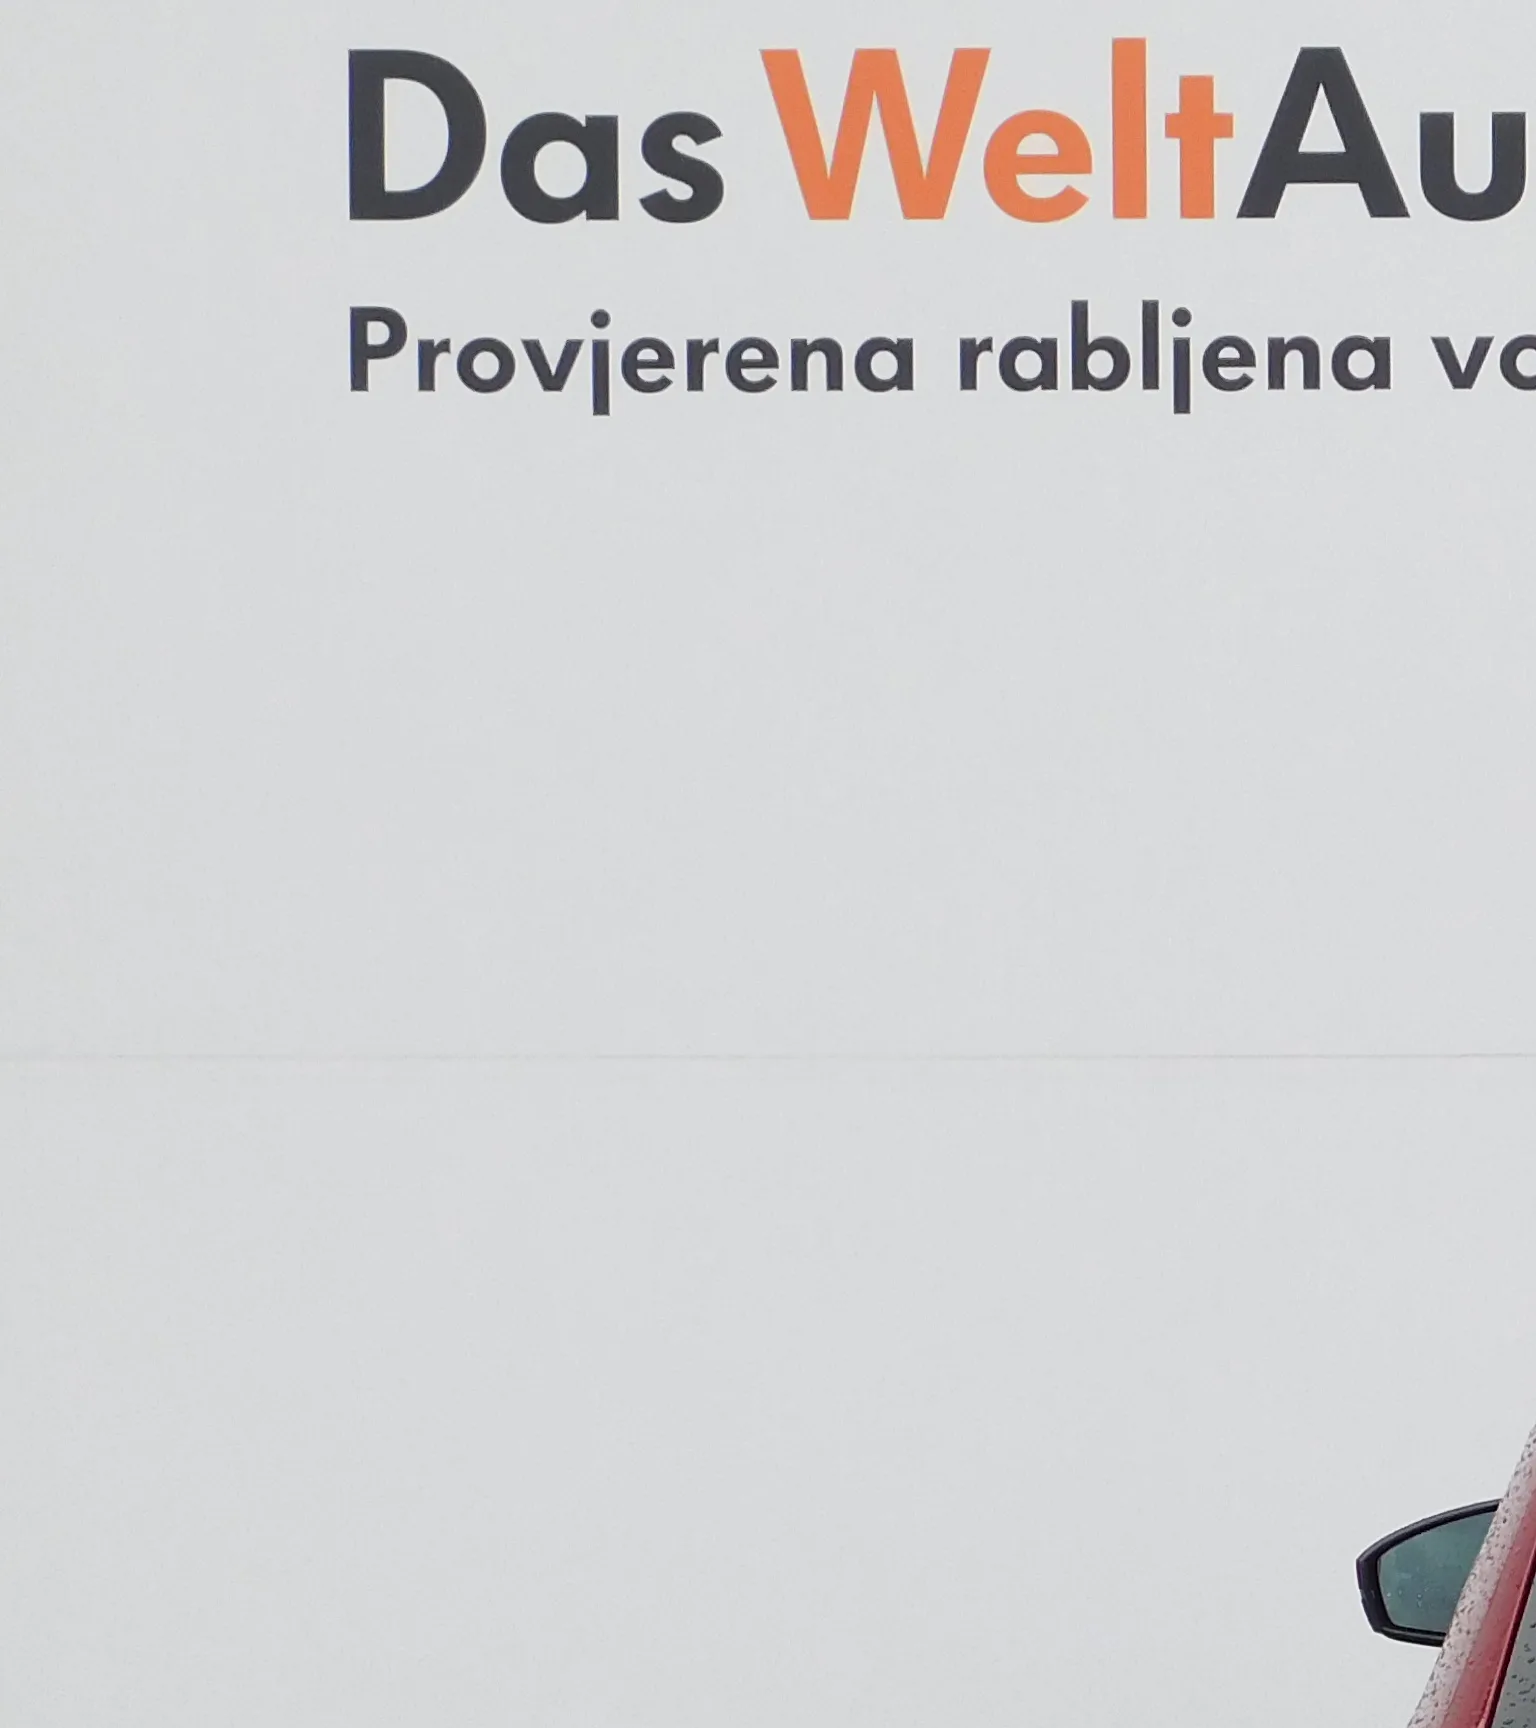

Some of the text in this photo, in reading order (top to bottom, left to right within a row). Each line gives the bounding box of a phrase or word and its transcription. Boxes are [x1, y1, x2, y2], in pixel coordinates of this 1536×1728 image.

[347, 48, 725, 225] Das
[349, 306, 914, 417] Provjerena
[959, 299, 1391, 415] rabljena
